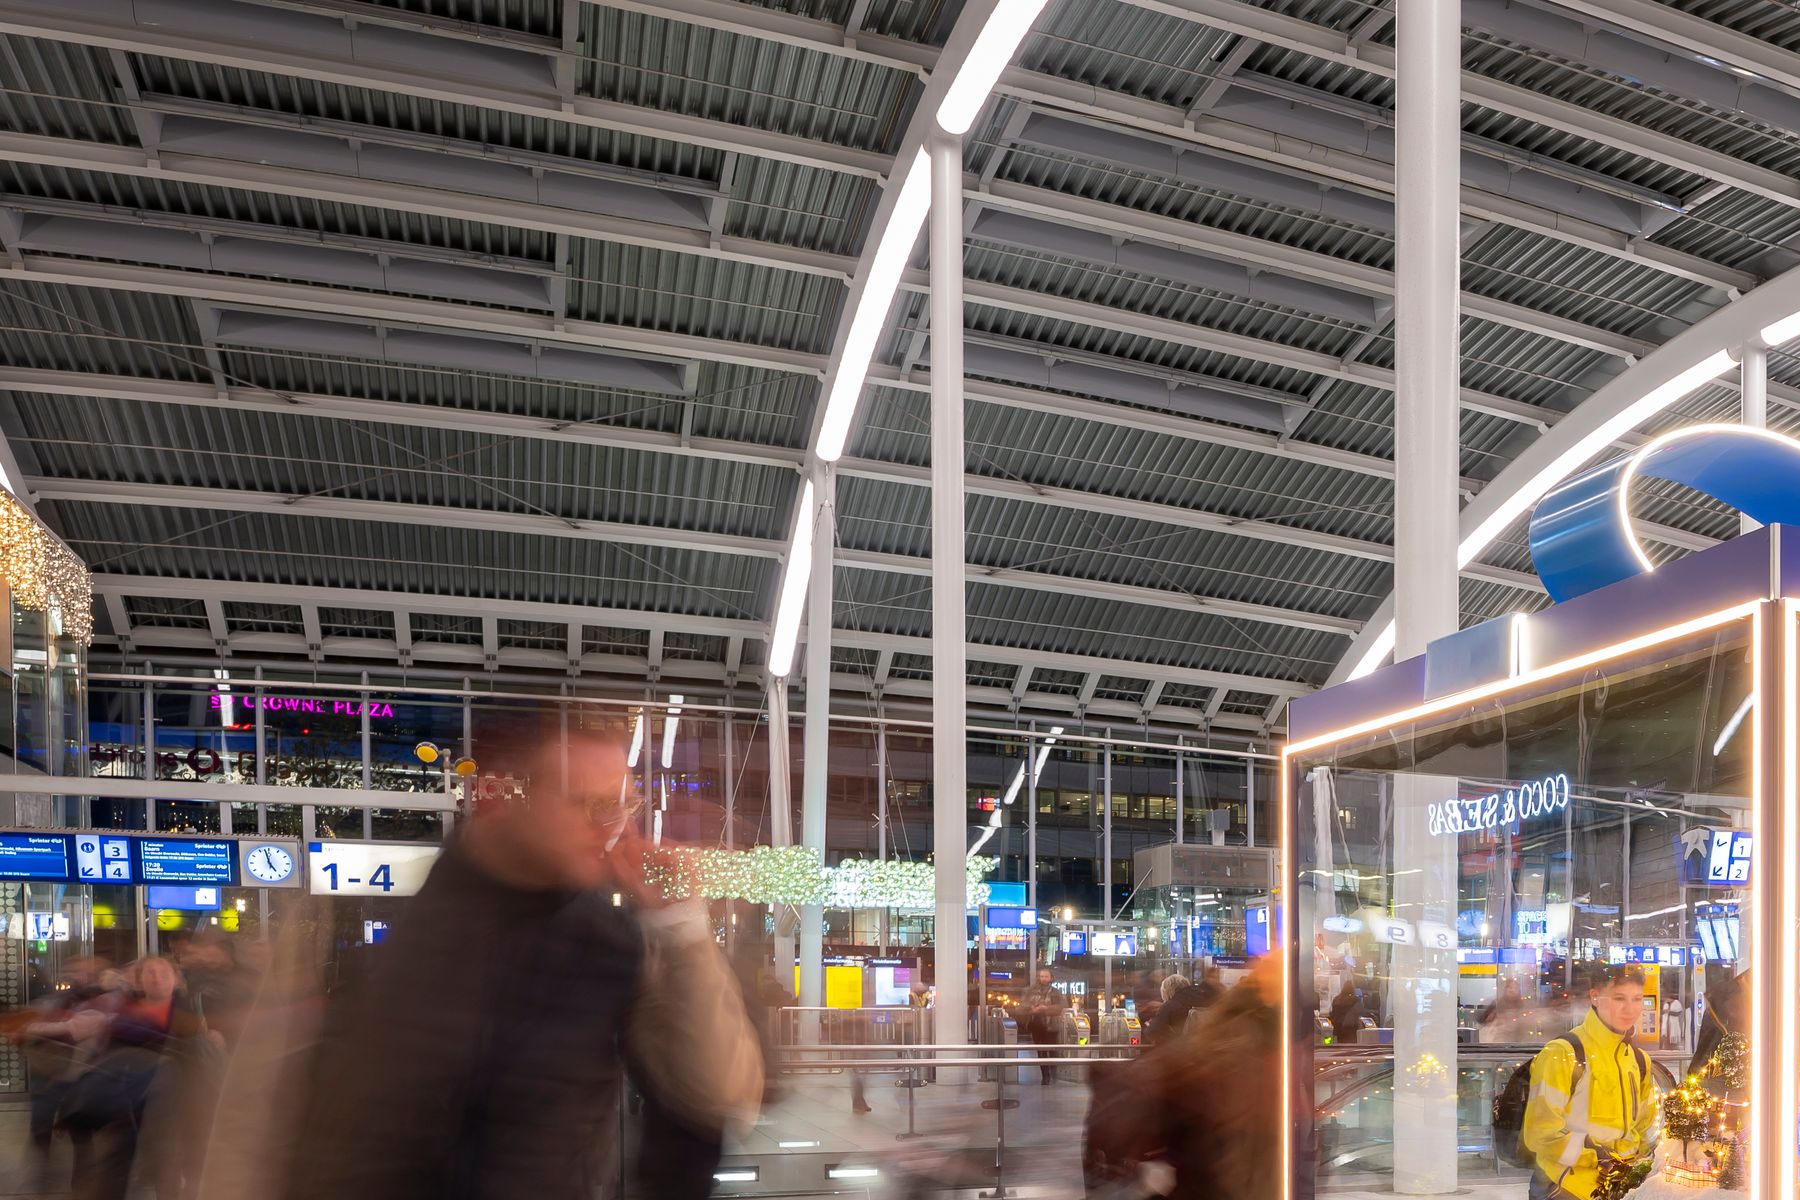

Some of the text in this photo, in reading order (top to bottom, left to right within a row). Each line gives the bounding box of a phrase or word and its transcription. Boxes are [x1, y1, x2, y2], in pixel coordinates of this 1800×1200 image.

[111, 846, 121, 857] 3
[112, 867, 123, 878] 4
[321, 862, 395, 892] 1-4
